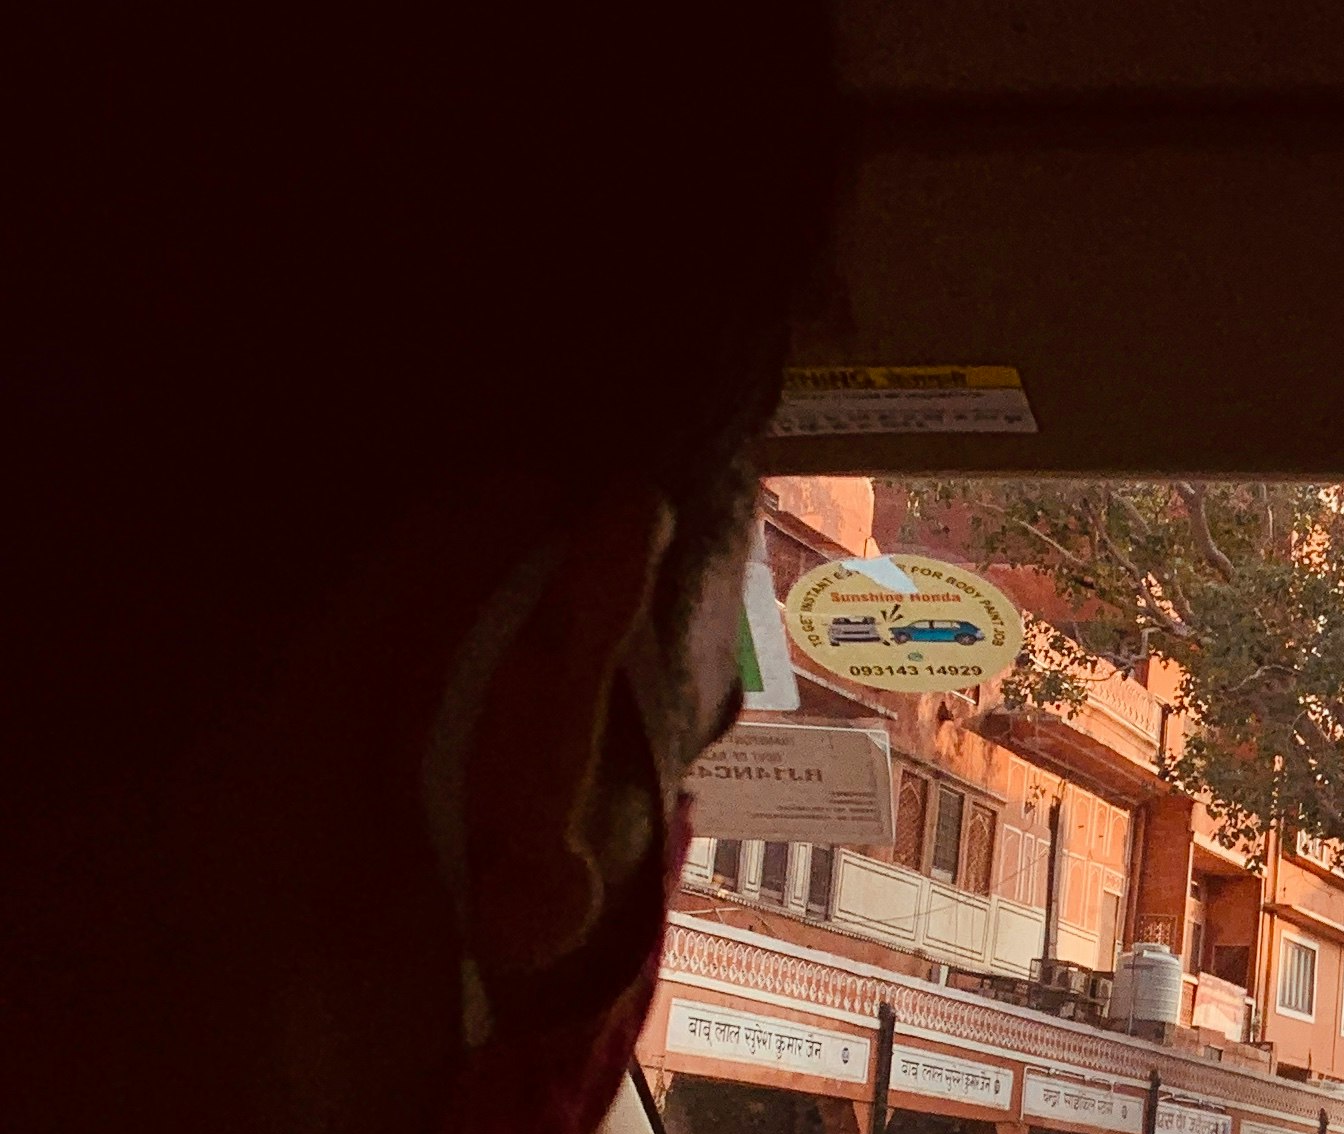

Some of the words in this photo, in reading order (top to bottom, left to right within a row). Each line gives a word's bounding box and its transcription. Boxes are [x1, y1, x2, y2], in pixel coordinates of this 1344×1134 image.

[801, 577, 834, 612] INSTANT
[830, 592, 903, 604] Sunshine
[909, 592, 962, 603] Honda
[910, 565, 944, 580] FOR
[946, 575, 982, 599] BODY
[979, 599, 1005, 627] PAINT
[849, 665, 919, 677] 093143
[927, 665, 983, 677] 14929
[714, 1021, 741, 1044] लाल
[744, 1024, 773, 1056] सुरेश
[775, 1033, 804, 1060] कुमार
